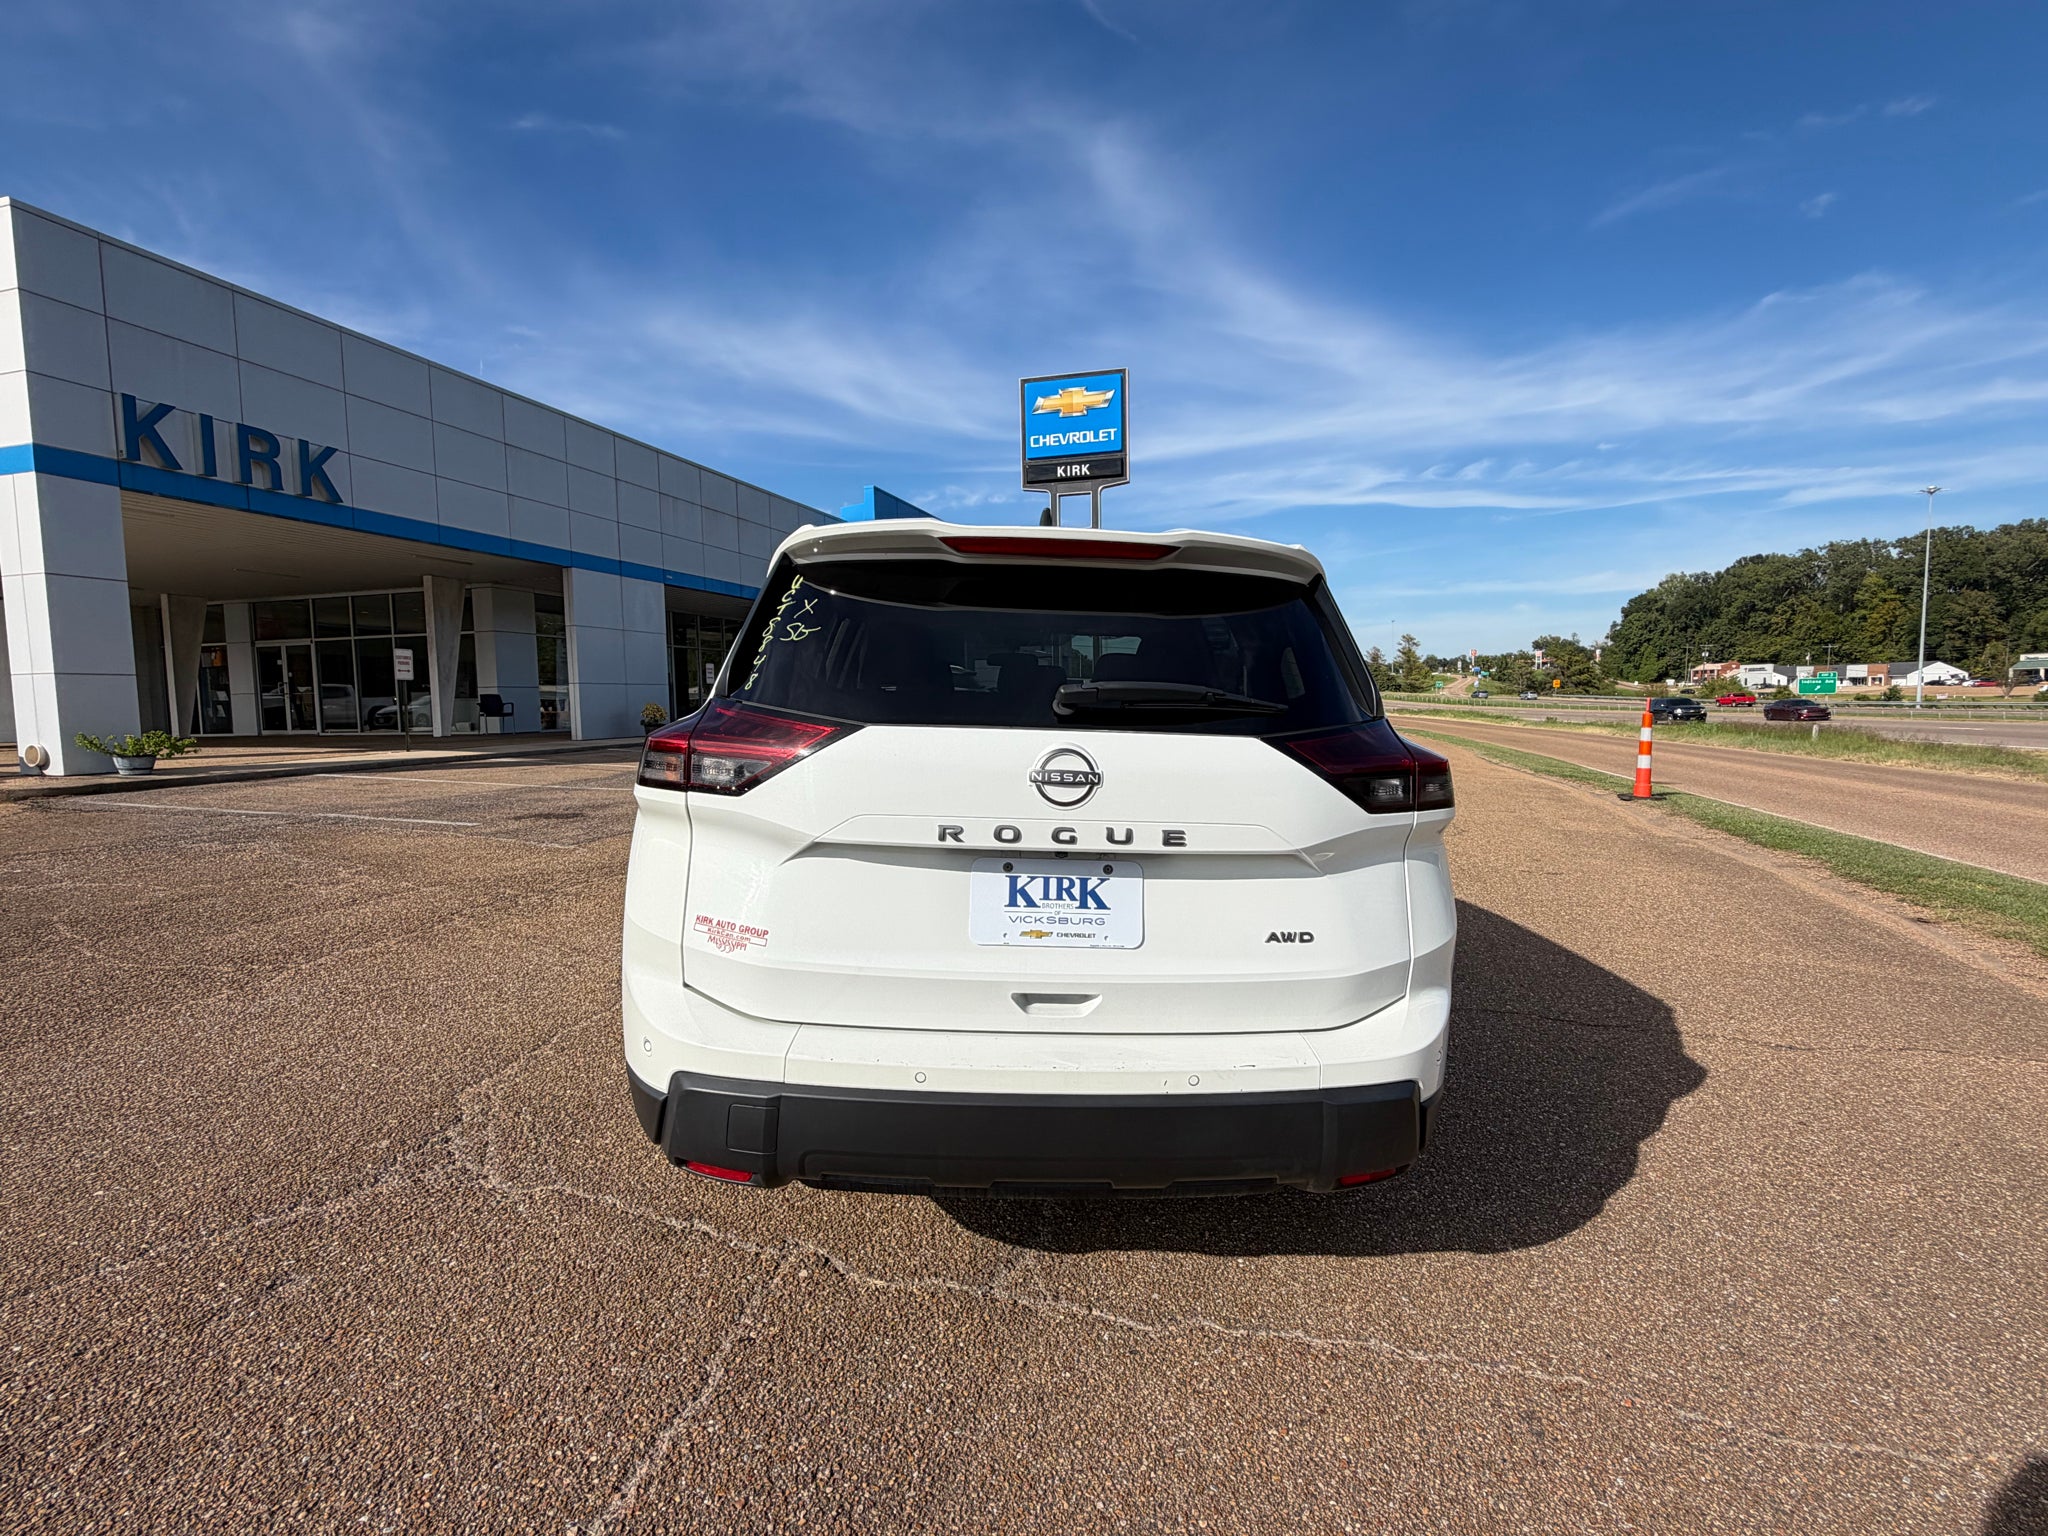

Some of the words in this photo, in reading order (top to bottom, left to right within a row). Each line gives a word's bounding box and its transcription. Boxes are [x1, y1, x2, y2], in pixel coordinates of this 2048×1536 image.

[1030, 428, 1118, 448] CHEVROLET
[120, 392, 344, 504] KIRK
[1057, 463, 1091, 477] KIRK
[1032, 771, 1100, 784] NISSAN
[937, 825, 1188, 848] ROGUE
[1004, 875, 1112, 911] KIRK
[1041, 902, 1075, 910] BROTHERS
[695, 914, 714, 926] KIRK
[715, 919, 737, 931] AUTO
[738, 924, 769, 938] GROUP
[1008, 915, 1106, 926] VICKSBURG
[707, 927, 751, 943] KirkCan.com
[1264, 931, 1315, 944] AWD
